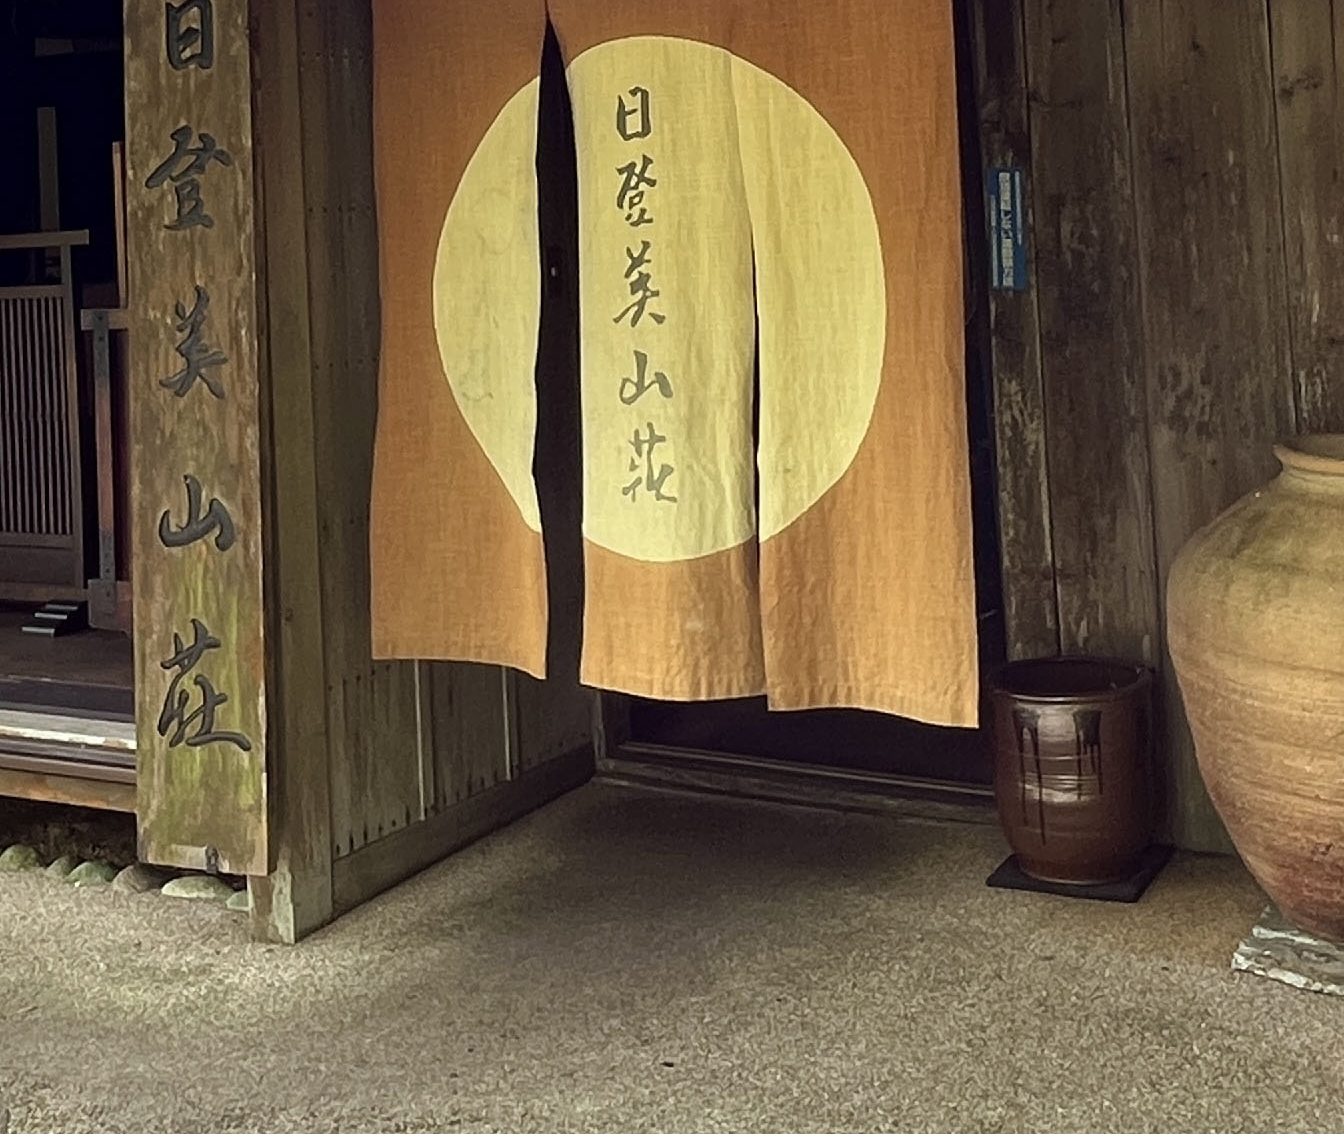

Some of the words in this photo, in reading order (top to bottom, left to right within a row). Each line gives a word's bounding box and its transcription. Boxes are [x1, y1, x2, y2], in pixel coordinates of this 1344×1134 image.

[612, 85, 678, 506] 日登美山荘
